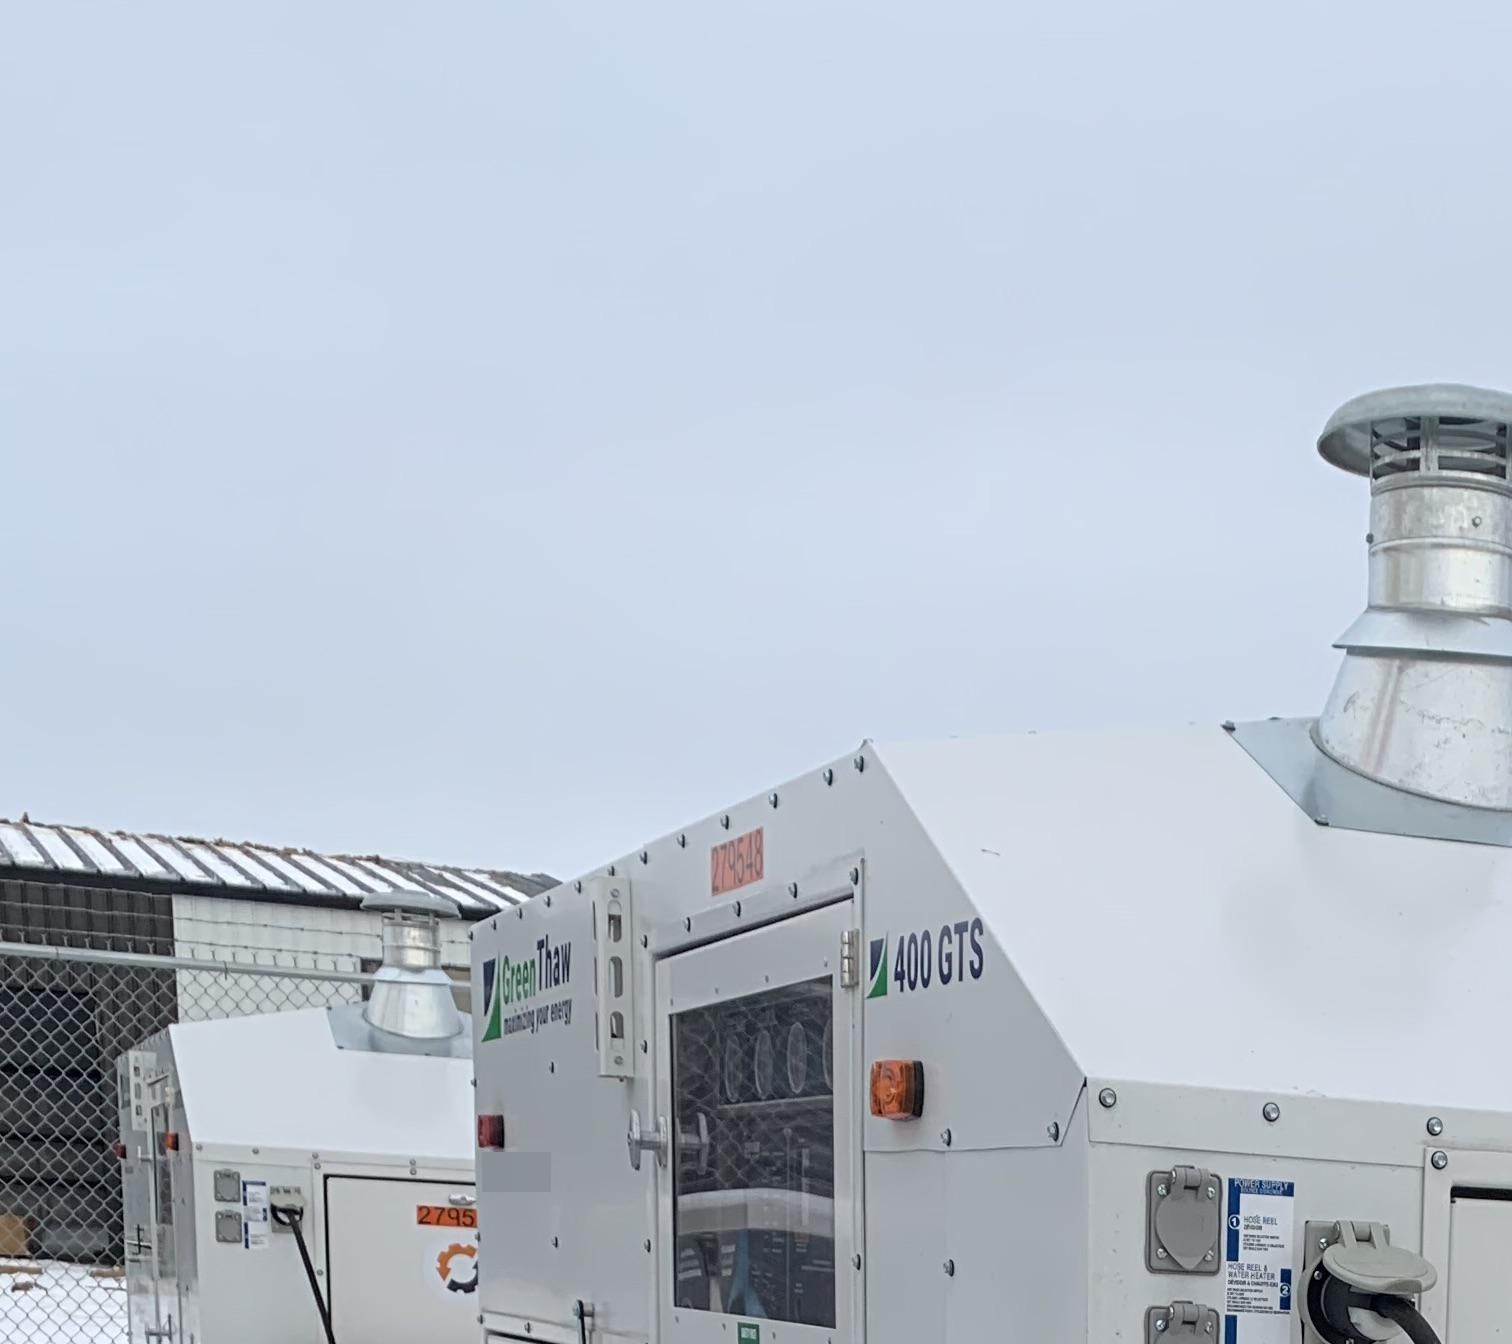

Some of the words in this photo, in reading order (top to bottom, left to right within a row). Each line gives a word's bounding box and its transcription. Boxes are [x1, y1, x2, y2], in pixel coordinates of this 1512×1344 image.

[712, 829, 763, 894] 279548
[894, 934, 932, 993] 400
[938, 917, 984, 986] GTS
[504, 1005, 535, 1036] maximizing
[535, 1004, 550, 1034] your
[550, 998, 573, 1027] energy
[1234, 1178, 1260, 1188] POWER
[1261, 1180, 1288, 1191] SUPPLY
[1243, 1215, 1261, 1225] HOSE
[1262, 1216, 1278, 1226] REEL
[1227, 1263, 1245, 1271] HOSE
[1246, 1264, 1261, 1272] REEL
[1227, 1271, 1250, 1279] WATER
[1250, 1272, 1275, 1281] HEATER
